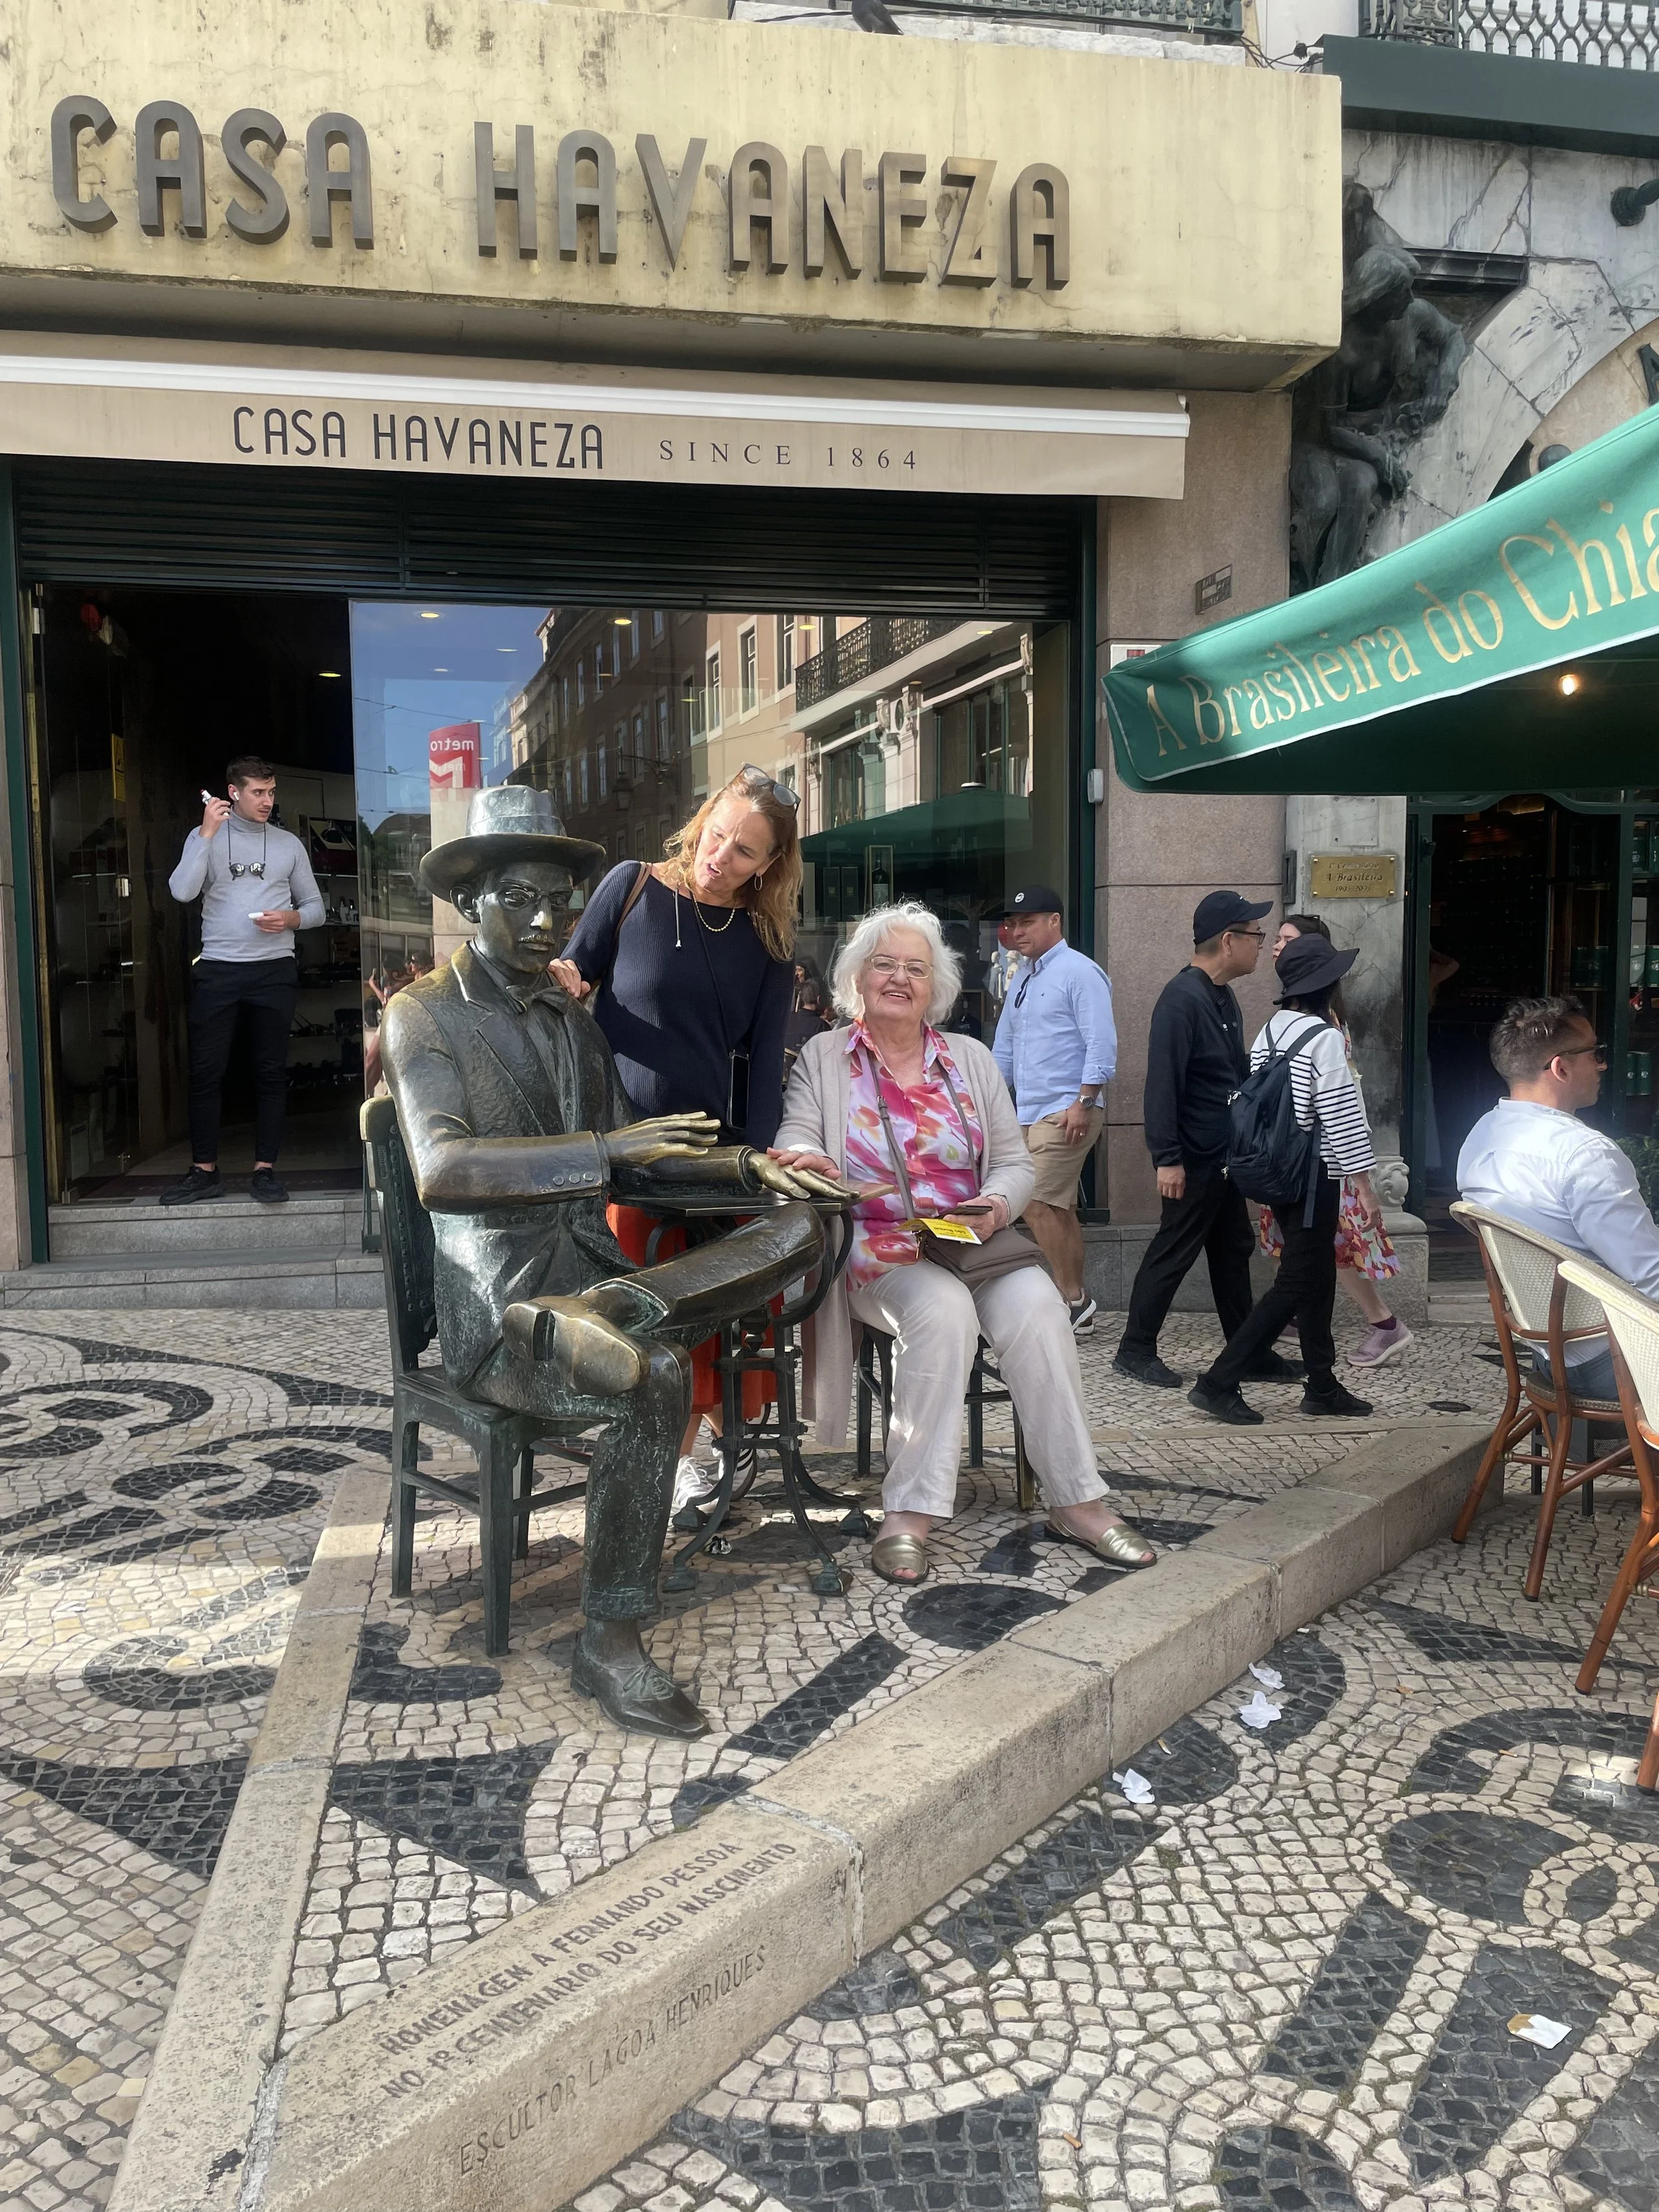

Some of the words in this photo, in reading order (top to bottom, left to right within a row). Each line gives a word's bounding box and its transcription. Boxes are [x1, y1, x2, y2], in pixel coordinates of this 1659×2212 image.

[50, 95, 374, 250] CASA
[474, 121, 1070, 290] HAVANEZA
[233, 406, 346, 458] CASA
[373, 413, 603, 470] HAVANEZA
[659, 439, 792, 466] SINCE
[827, 446, 916, 470] 1864
[1146, 684, 1187, 757] A
[1178, 626, 1421, 745] Brasileira
[1414, 580, 1504, 664] do
[380, 1965, 534, 2055] HOMENAGEM
[532, 1953, 557, 1966] A
[549, 1885, 664, 1953] FERNANDO
[660, 1842, 743, 1887] PESSOA
[380, 2070, 424, 2098] NO
[597, 1941, 637, 1964] DO
[632, 1911, 683, 1941] SEU
[676, 1843, 796, 1915] NASCIMENTO
[460, 2075, 577, 2176] ESCULTOR
[589, 2020, 656, 2093] LAGOA
[666, 1945, 765, 2031] HENRIQUES
